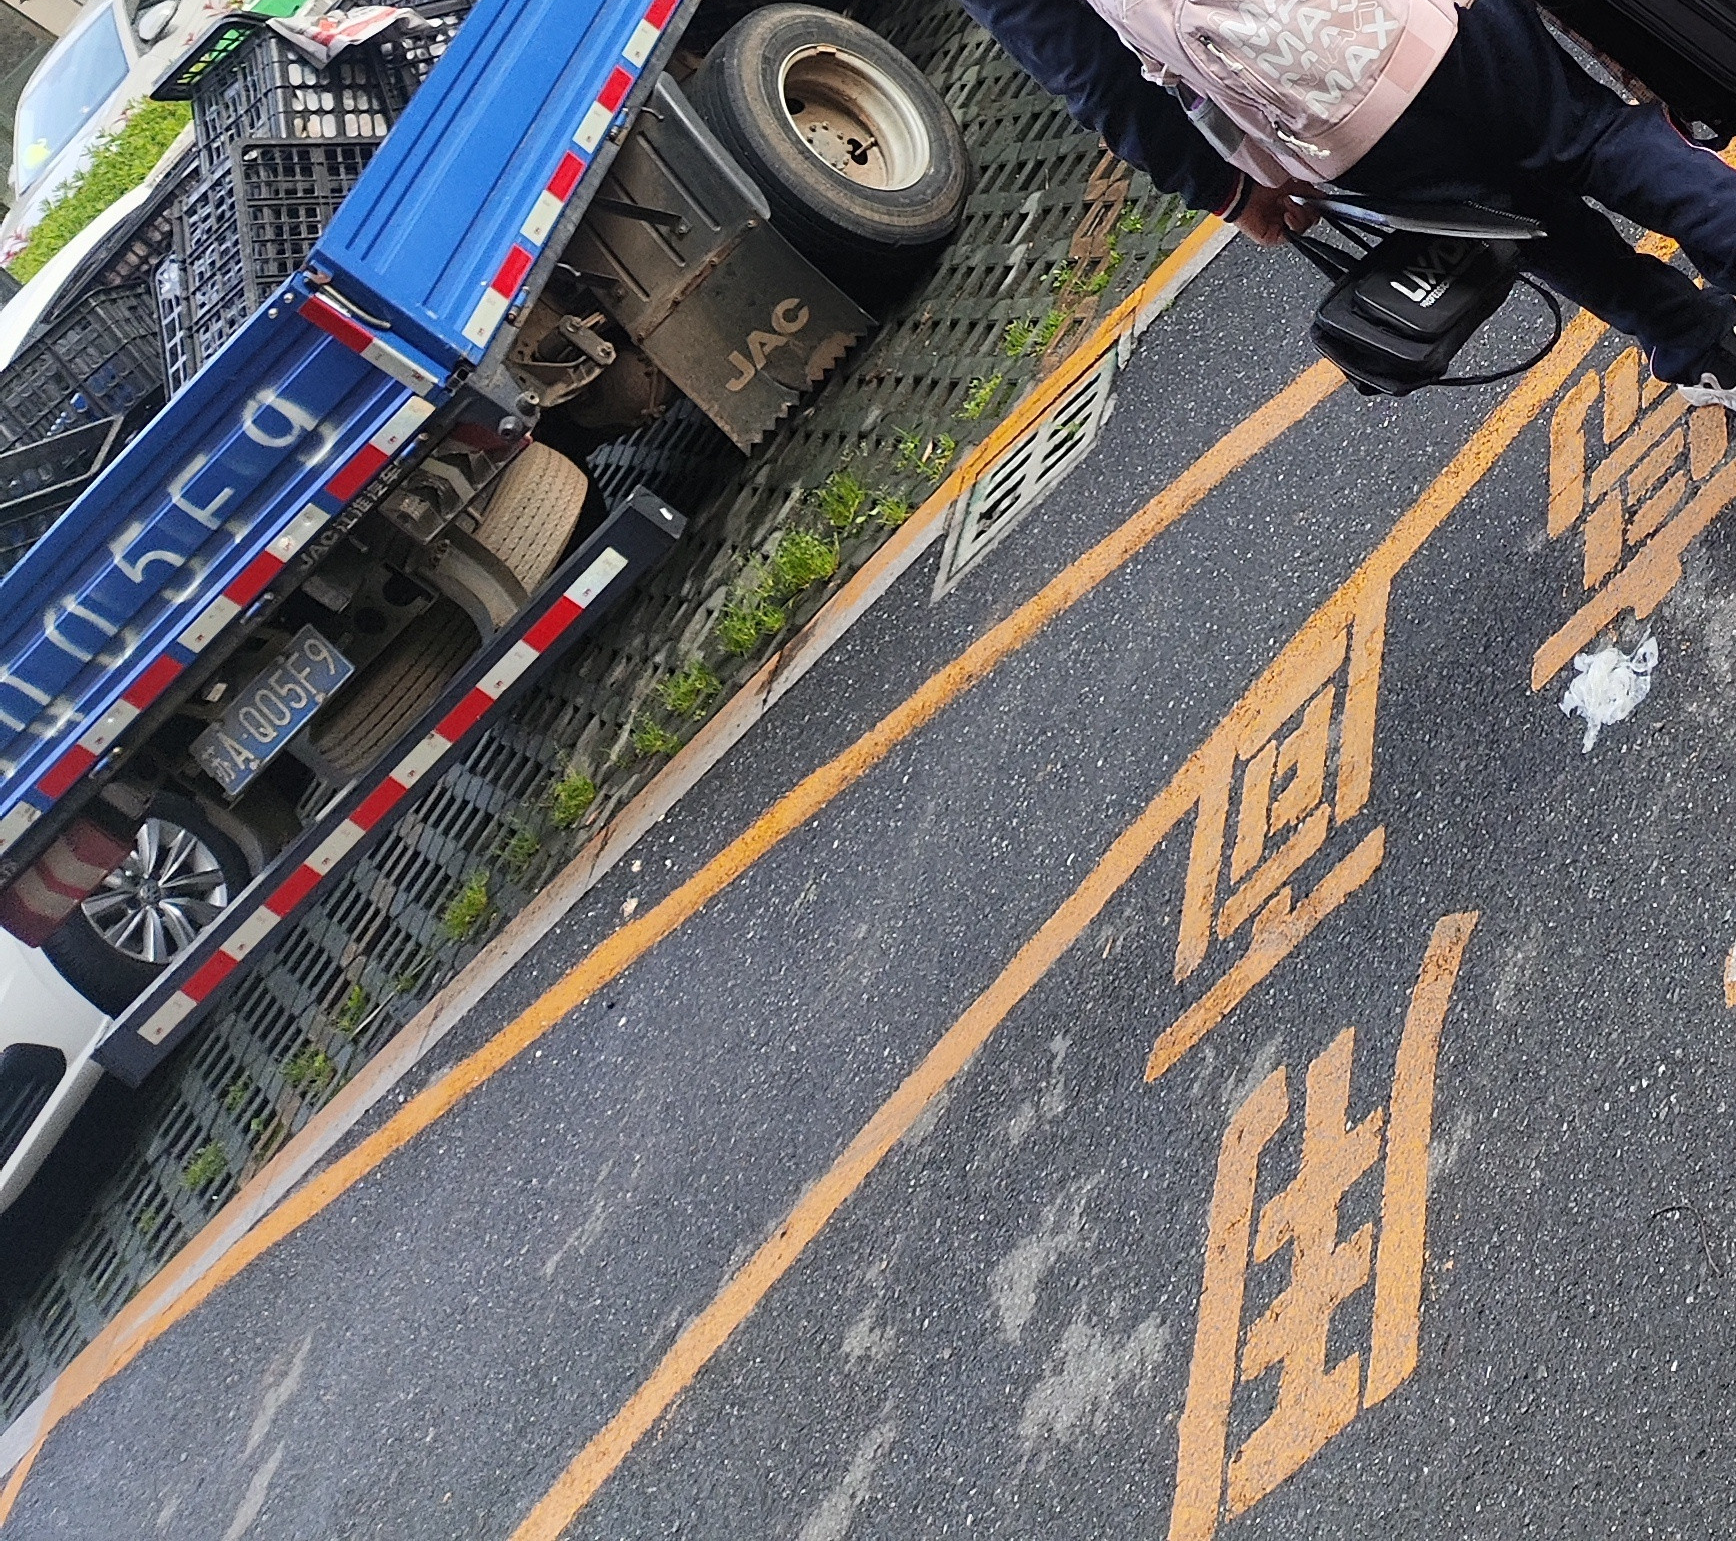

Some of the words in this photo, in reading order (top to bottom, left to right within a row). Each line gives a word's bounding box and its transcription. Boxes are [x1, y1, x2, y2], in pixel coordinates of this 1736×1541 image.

[1305, 6, 1398, 118] MAX
[725, 298, 810, 391] JAC
[0, 387, 336, 779] Q05F9
